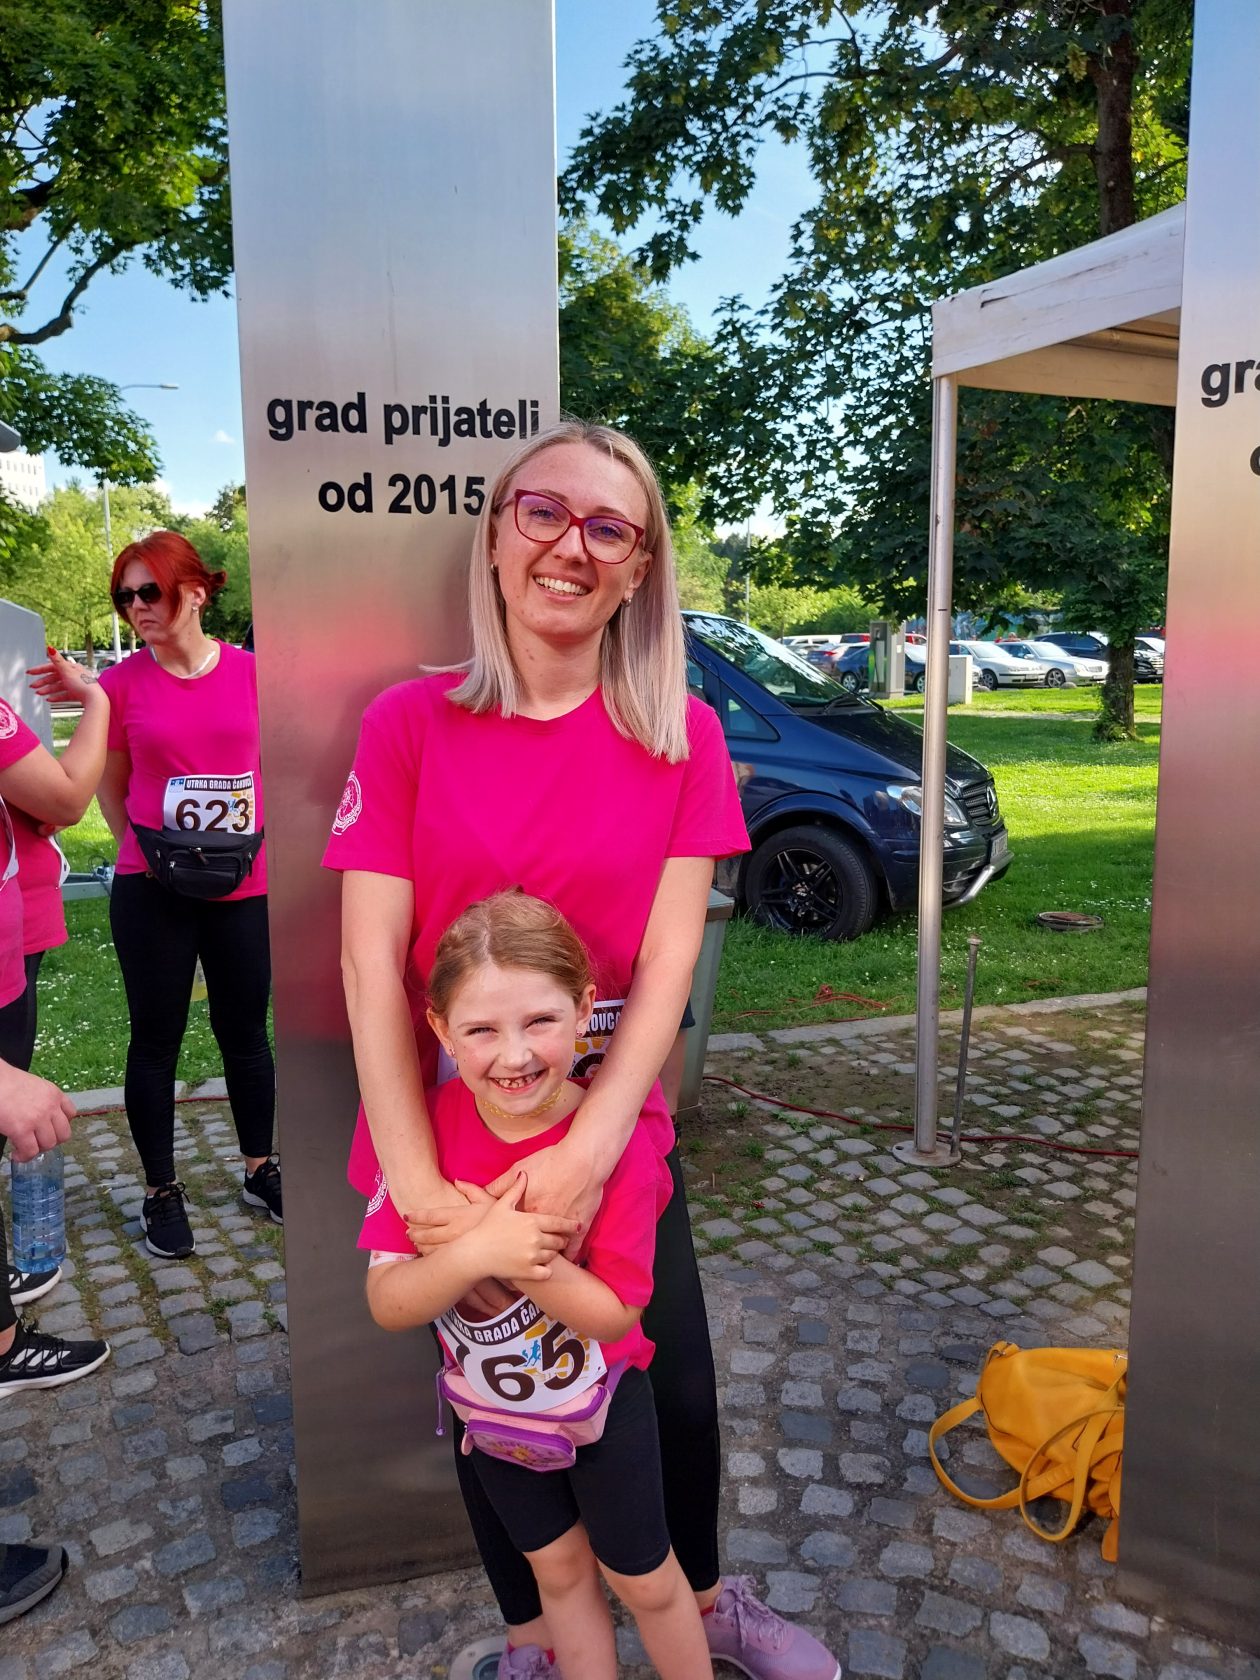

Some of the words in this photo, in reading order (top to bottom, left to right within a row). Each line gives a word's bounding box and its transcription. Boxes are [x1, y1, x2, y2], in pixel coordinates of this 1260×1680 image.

[266, 391, 368, 441] grad
[318, 472, 374, 513] od
[387, 473, 486, 516] 2015
[176, 798, 250, 832] 623
[474, 1317, 521, 1343] GRADA
[520, 1302, 541, 1326] ČA
